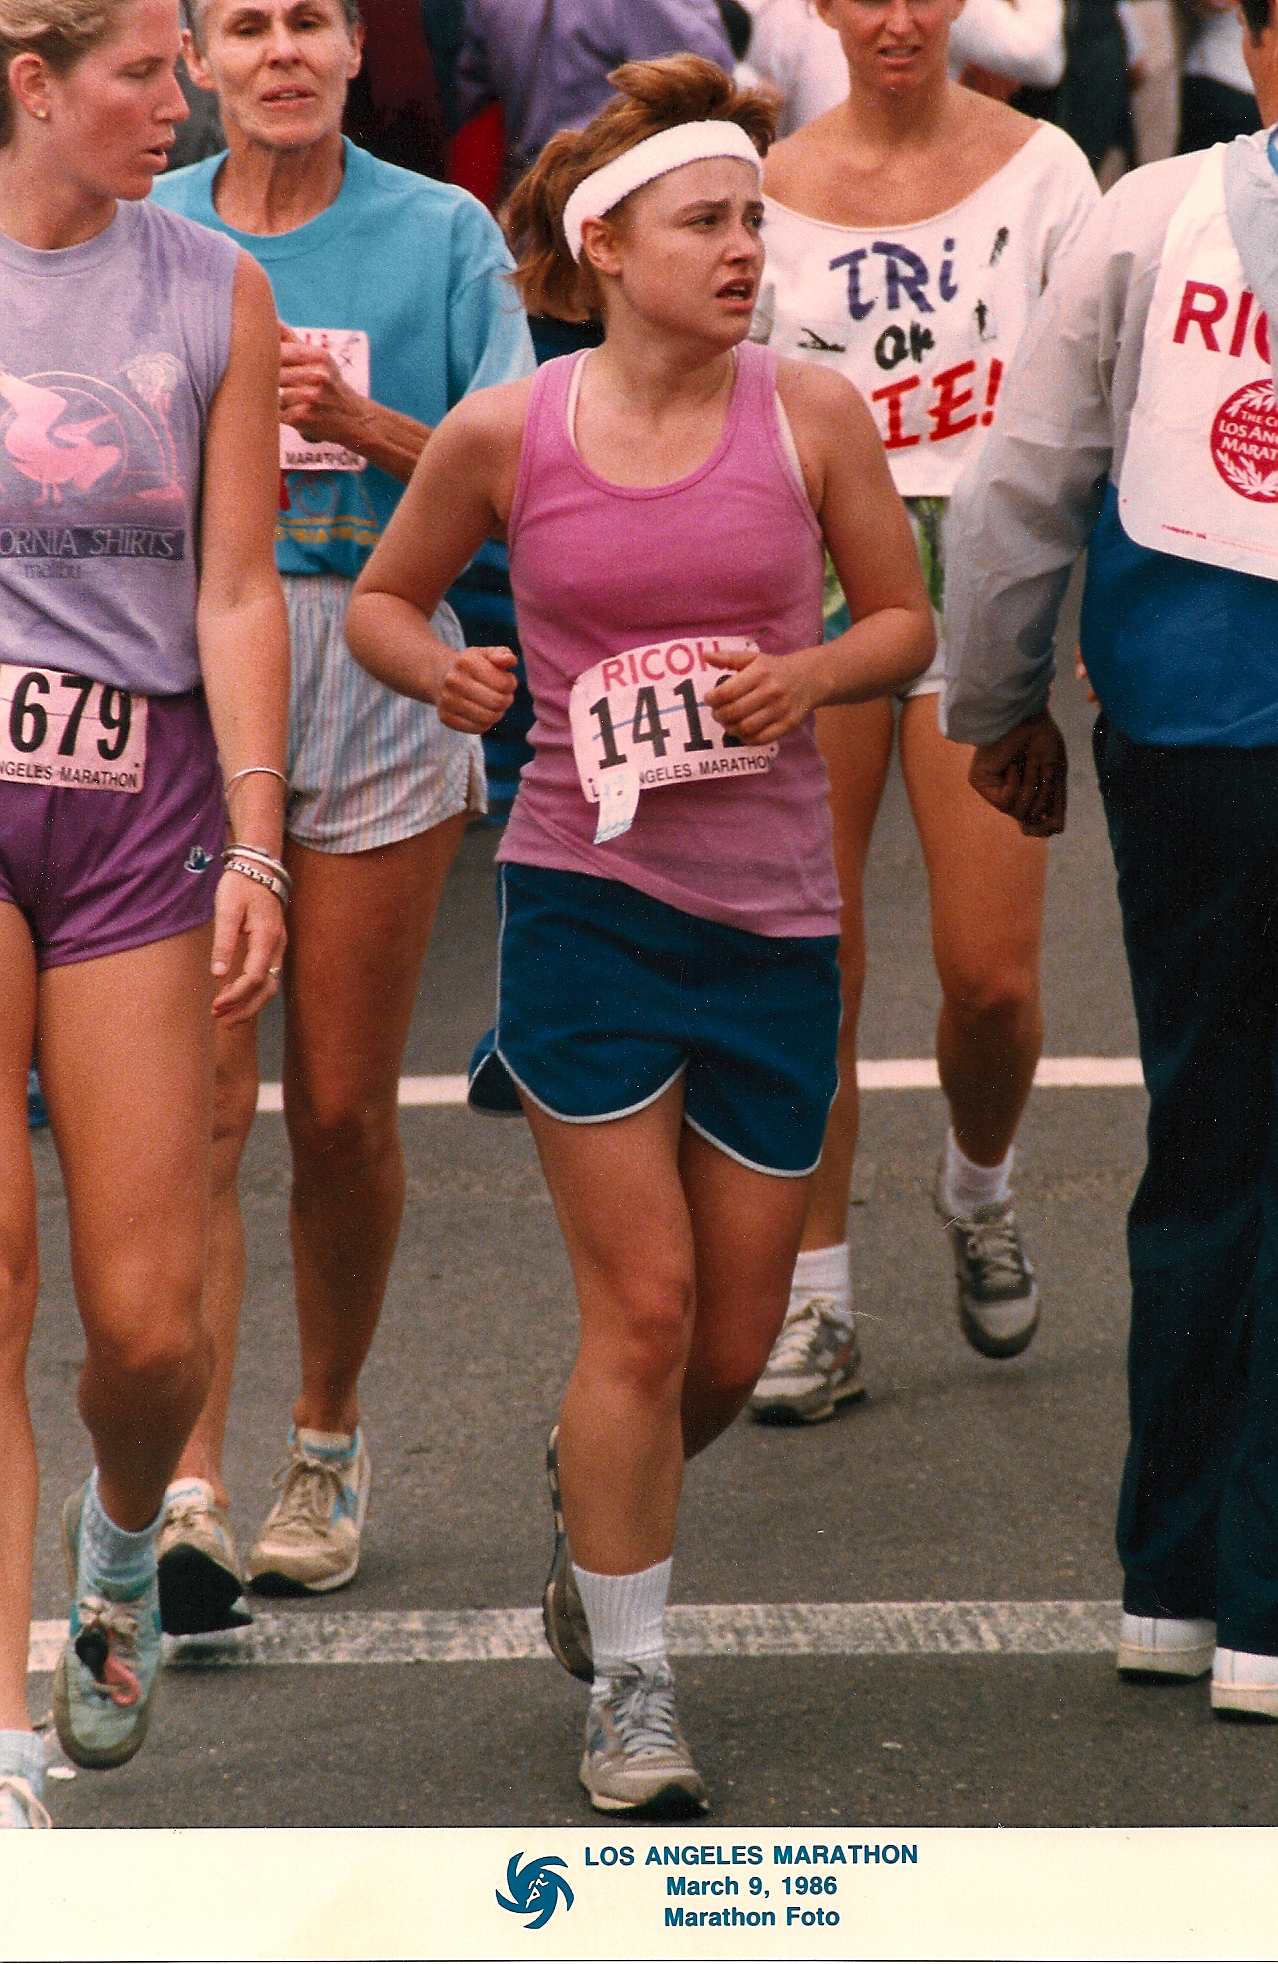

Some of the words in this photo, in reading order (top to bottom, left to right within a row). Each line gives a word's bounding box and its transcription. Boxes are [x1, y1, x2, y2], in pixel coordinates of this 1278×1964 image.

[1241, 410, 1263, 424] THE
[1218, 420, 1248, 438] LOS
[285, 452, 360, 466] MARATHON
[90, 528, 175, 557] SHIRTS
[9, 671, 132, 761] 679
[699, 755, 774, 775] MARATHON
[60, 766, 139, 788] MARATHON
